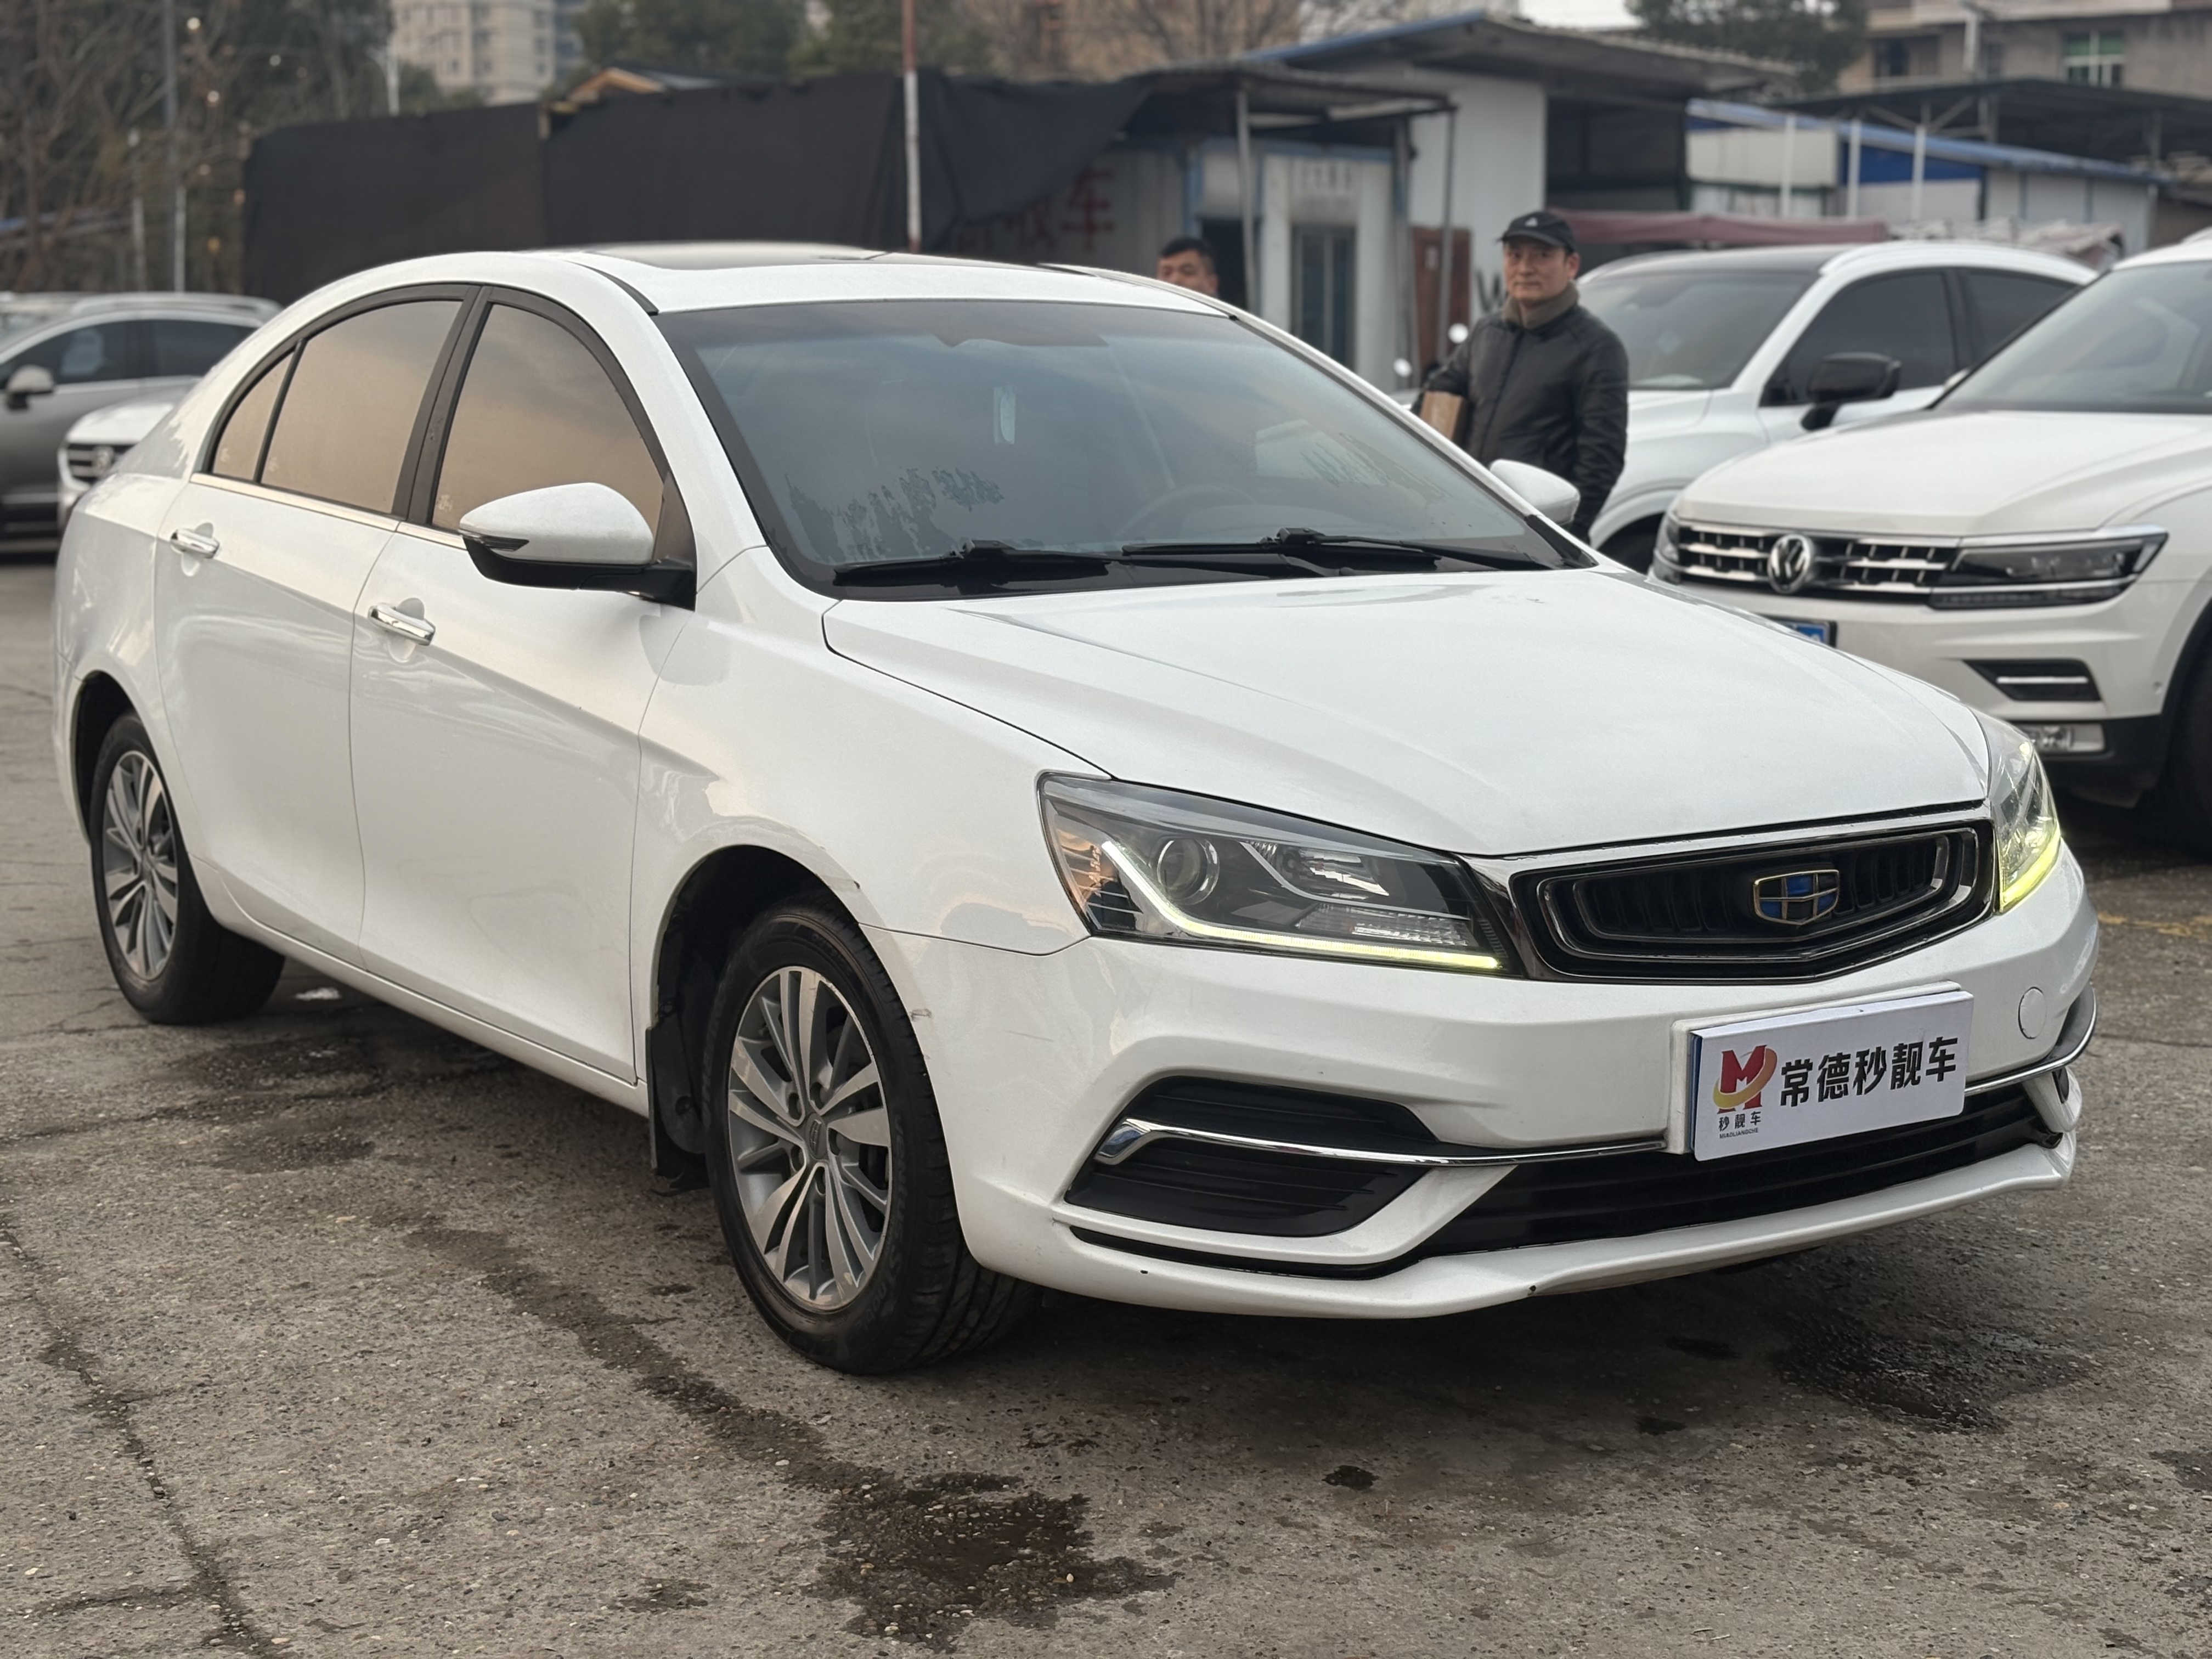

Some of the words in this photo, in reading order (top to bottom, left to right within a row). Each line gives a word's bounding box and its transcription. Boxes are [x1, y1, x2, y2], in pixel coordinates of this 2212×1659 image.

[1780, 1036, 1958, 1108] 常德秒靓车
[1718, 1111, 1761, 1132] 秒靓车
